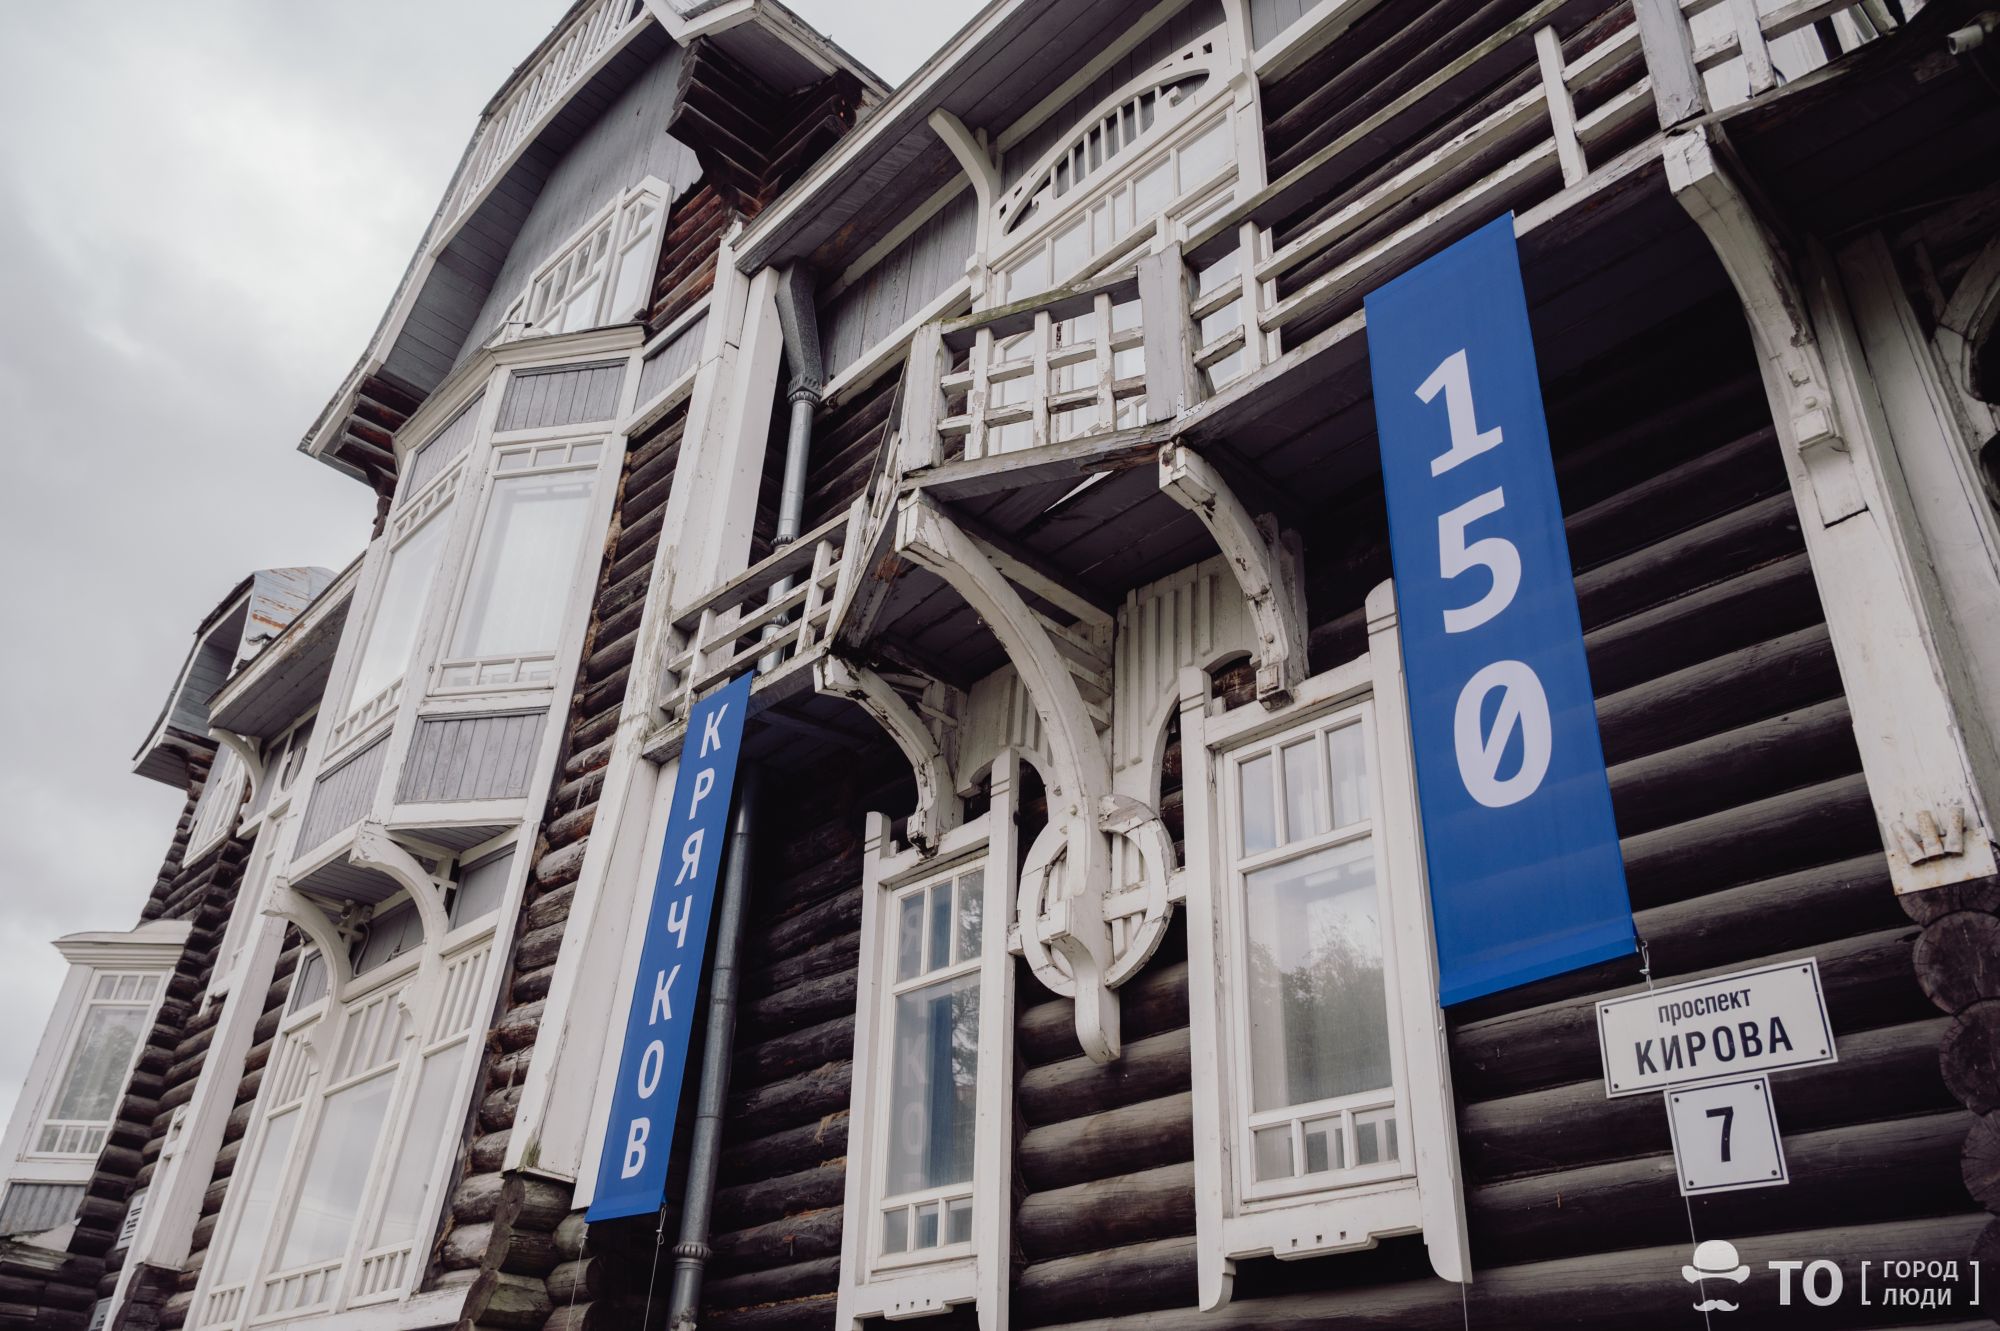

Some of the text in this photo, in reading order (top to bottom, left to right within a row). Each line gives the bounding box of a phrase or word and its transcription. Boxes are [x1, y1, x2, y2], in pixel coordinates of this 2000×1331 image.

[1414, 347, 1552, 808] 150
[620, 703, 729, 1180] КРЯЧКОВ
[1657, 988, 1752, 1026] проспект
[1634, 1015, 1794, 1076] КИРОВА
[1705, 1105, 1735, 1163] 7
